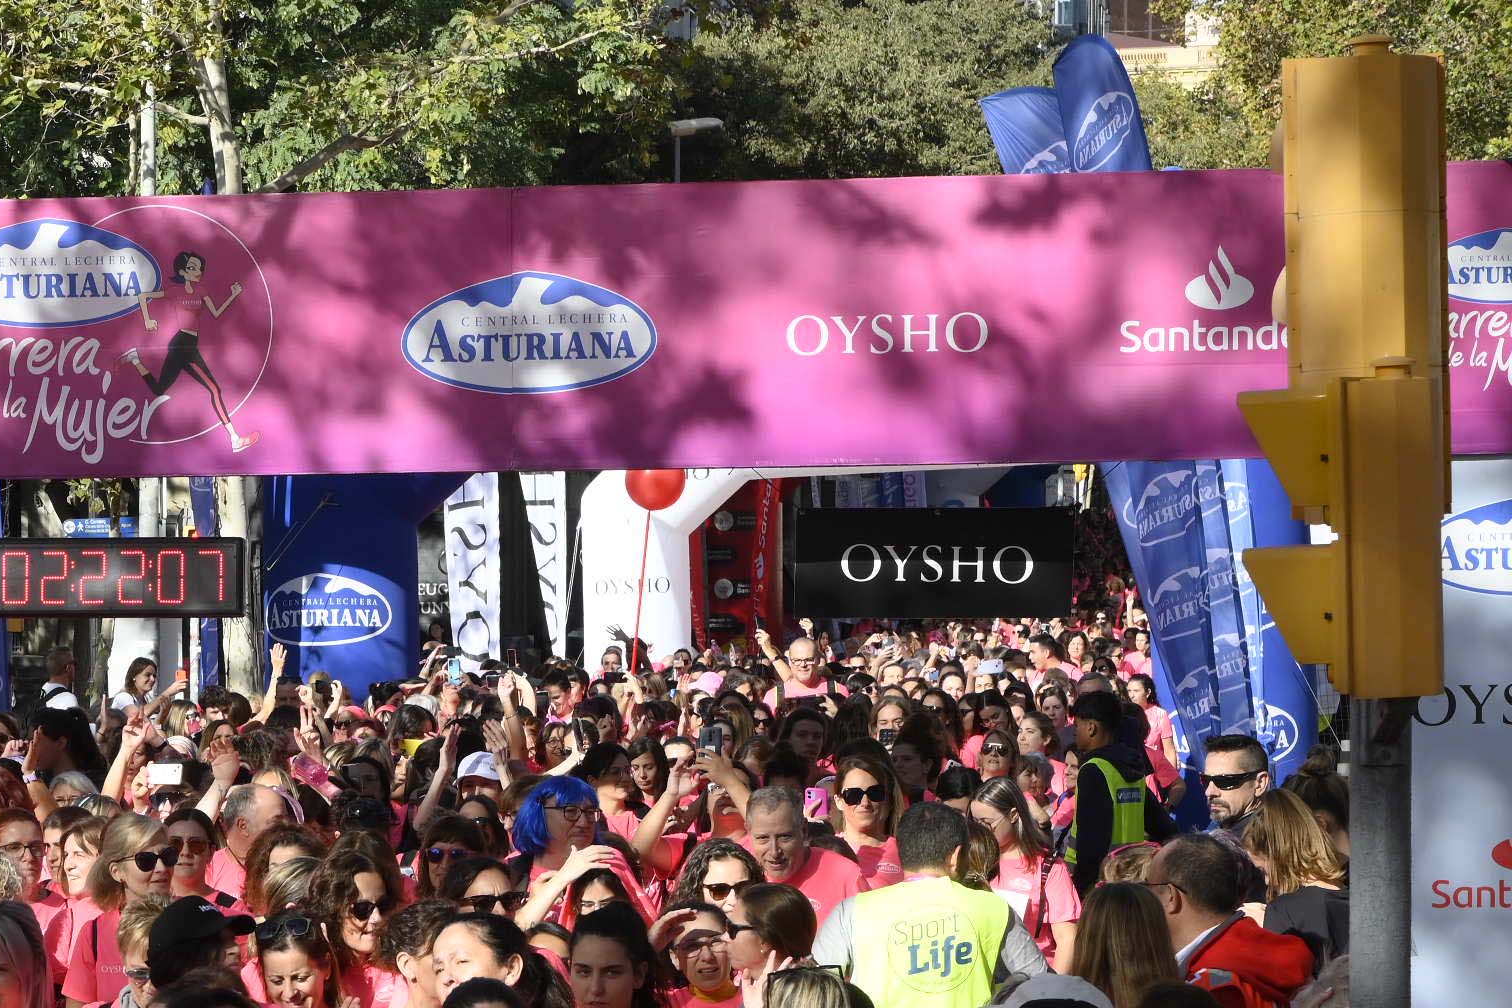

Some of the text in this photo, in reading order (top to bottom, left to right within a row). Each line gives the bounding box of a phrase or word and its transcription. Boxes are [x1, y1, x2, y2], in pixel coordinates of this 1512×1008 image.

[65, 255, 137, 266] LECHERA
[423, 319, 637, 363] ASTURIANA
[461, 313, 628, 327] CENTRAL LECHERA
[787, 311, 989, 355] OYSHO
[3, 379, 27, 419] la
[23, 370, 171, 465] Mujer
[2, 551, 224, 605] 02:22:07
[840, 542, 1034, 585] OYSHO
[270, 606, 382, 629] ASTURIANA
[283, 597, 378, 606] CENTRAL LECHERA
[893, 911, 960, 945] Sport
[908, 935, 973, 977] Life
